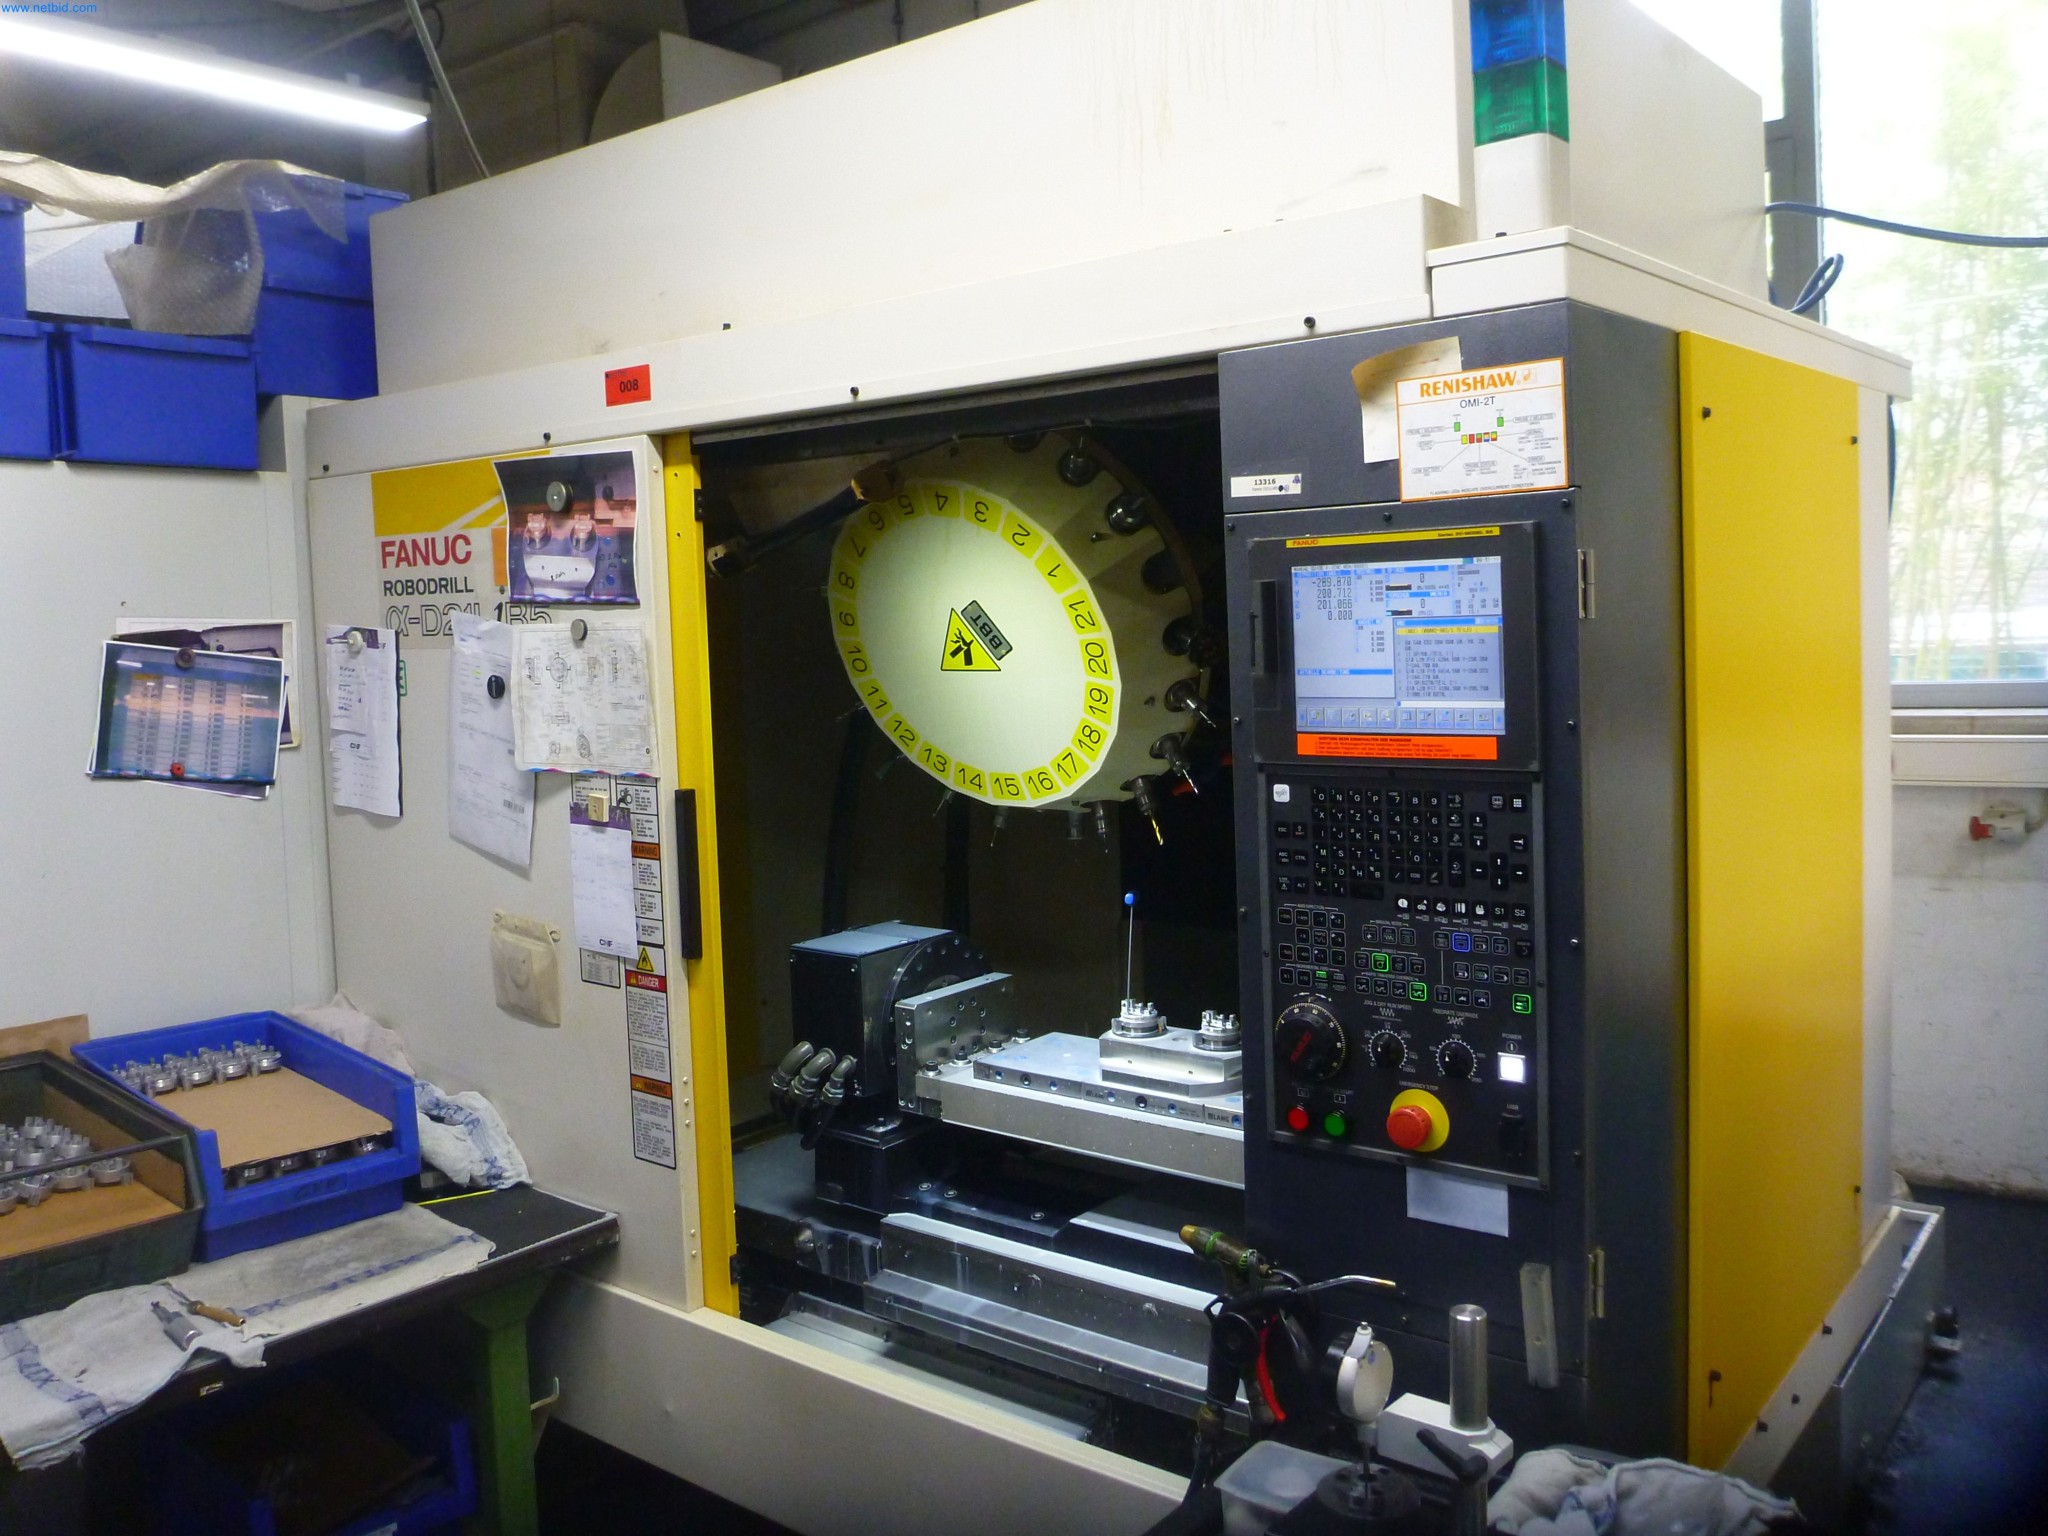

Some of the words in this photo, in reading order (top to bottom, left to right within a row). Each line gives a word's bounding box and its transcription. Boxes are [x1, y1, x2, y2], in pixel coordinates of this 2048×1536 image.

[620, 378, 638, 392] 008
[1420, 370, 1517, 398] RENISHAW
[1460, 396, 1496, 408] OMI-2T
[898, 494, 914, 516] 5
[934, 491, 948, 512] 4
[974, 500, 989, 522] 3
[1012, 523, 1031, 547] 2
[381, 533, 472, 569] FANUC
[838, 571, 855, 590] 8
[1048, 563, 1062, 578] 1
[383, 576, 474, 596] ROBODRILL
[1312, 577, 1352, 588] -289.870
[1318, 588, 1352, 598] 200.712
[1068, 599, 1096, 630] 21
[1318, 600, 1352, 610] 201.066
[1328, 610, 1352, 620] 0.000
[839, 611, 855, 627] 9
[970, 612, 1003, 650] BBT
[848, 645, 868, 672] 10
[1088, 641, 1108, 674] 20
[867, 685, 888, 710] 11
[1089, 687, 1109, 715] 19
[894, 719, 916, 748] 12
[1077, 724, 1102, 752] 18
[924, 747, 948, 773] 13
[1056, 752, 1080, 776] 17
[958, 767, 983, 790] 14
[994, 776, 1020, 796] 15
[1027, 771, 1054, 794] 16
[638, 975, 659, 988] DANGER
